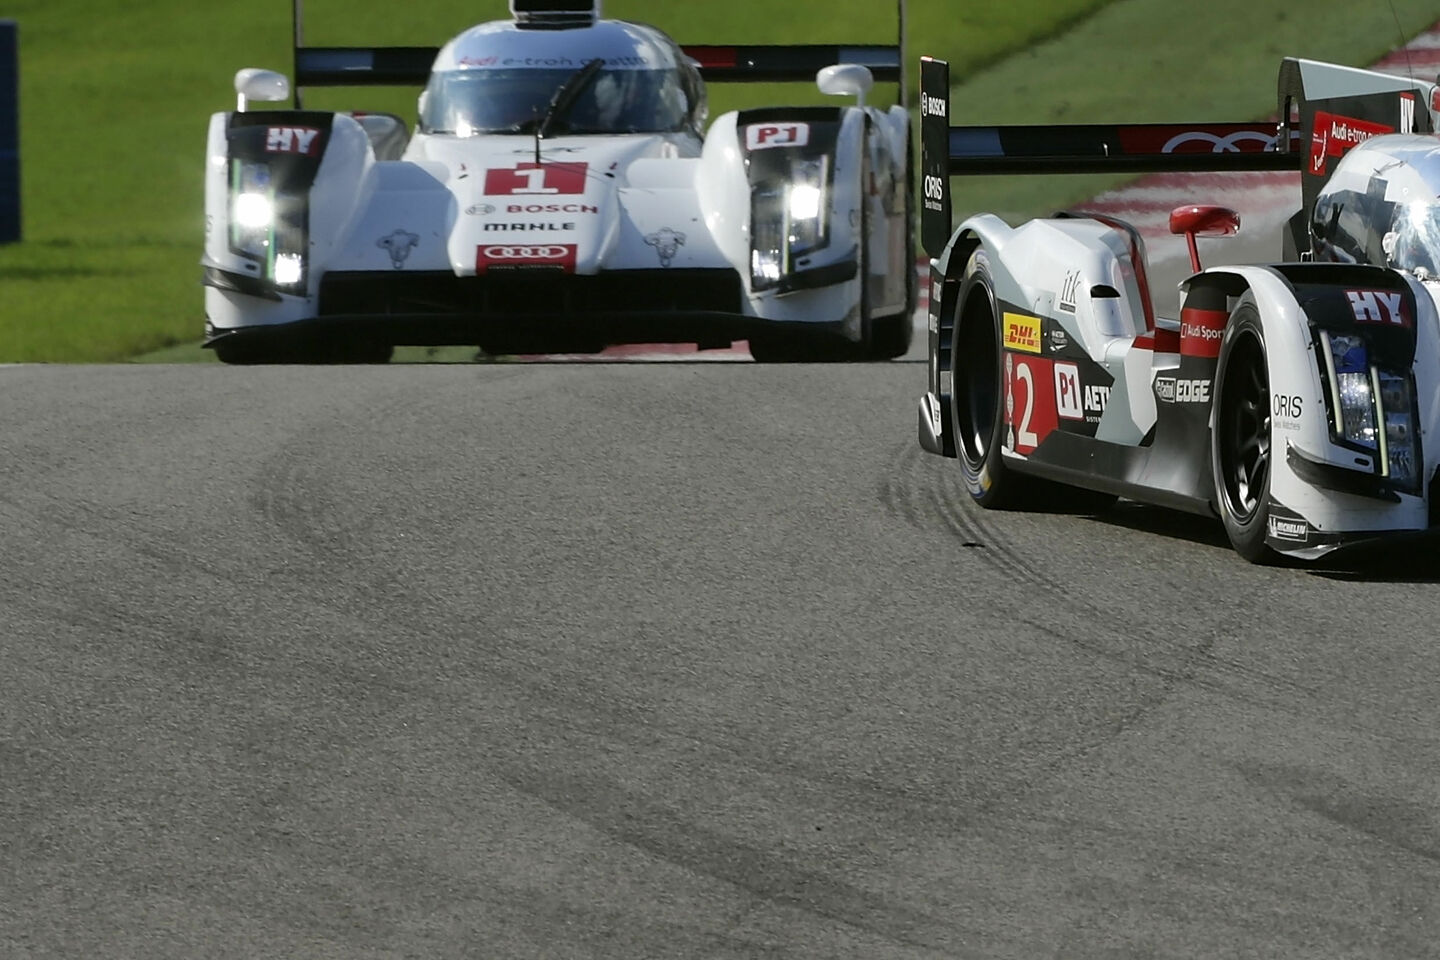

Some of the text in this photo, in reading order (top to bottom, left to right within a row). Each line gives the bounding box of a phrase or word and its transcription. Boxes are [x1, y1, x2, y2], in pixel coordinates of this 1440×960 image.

[928, 96, 946, 118] BOSCH
[1400, 96, 1415, 134] HY
[266, 127, 318, 154] HY
[757, 126, 798, 144] P1
[1331, 120, 1347, 141] Audi
[511, 168, 559, 194] 1
[924, 175, 942, 199] ORIS
[506, 204, 599, 214] BOSCH
[483, 222, 576, 232] MAHLE
[1346, 291, 1402, 324] HY
[1008, 323, 1036, 347] DHL
[1187, 324, 1201, 338] Audi
[1059, 371, 1079, 411] P1
[1175, 379, 1211, 402] EDGE
[1016, 362, 1039, 448] 2
[1273, 394, 1303, 418] ORIS
